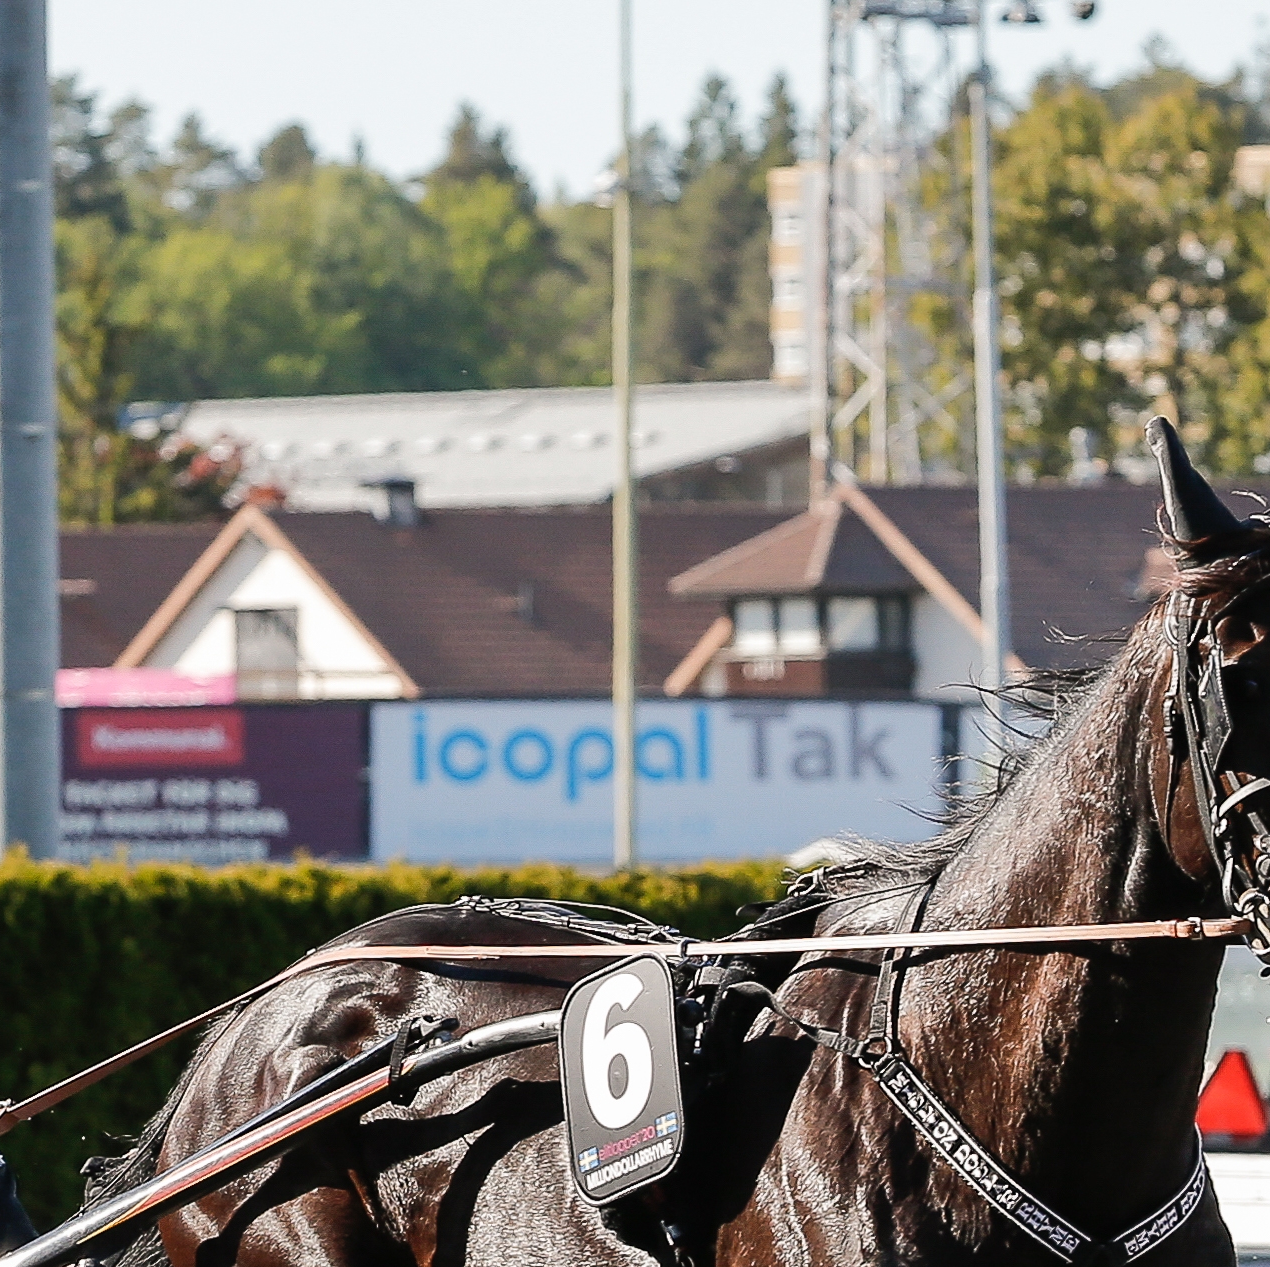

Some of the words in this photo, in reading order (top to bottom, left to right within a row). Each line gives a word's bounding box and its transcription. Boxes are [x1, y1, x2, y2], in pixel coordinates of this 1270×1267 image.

[413, 708, 711, 800] icopal
[733, 708, 895, 781] Tak
[583, 973, 653, 1130] 6
[1015, 1201, 1080, 1254] RHYME
